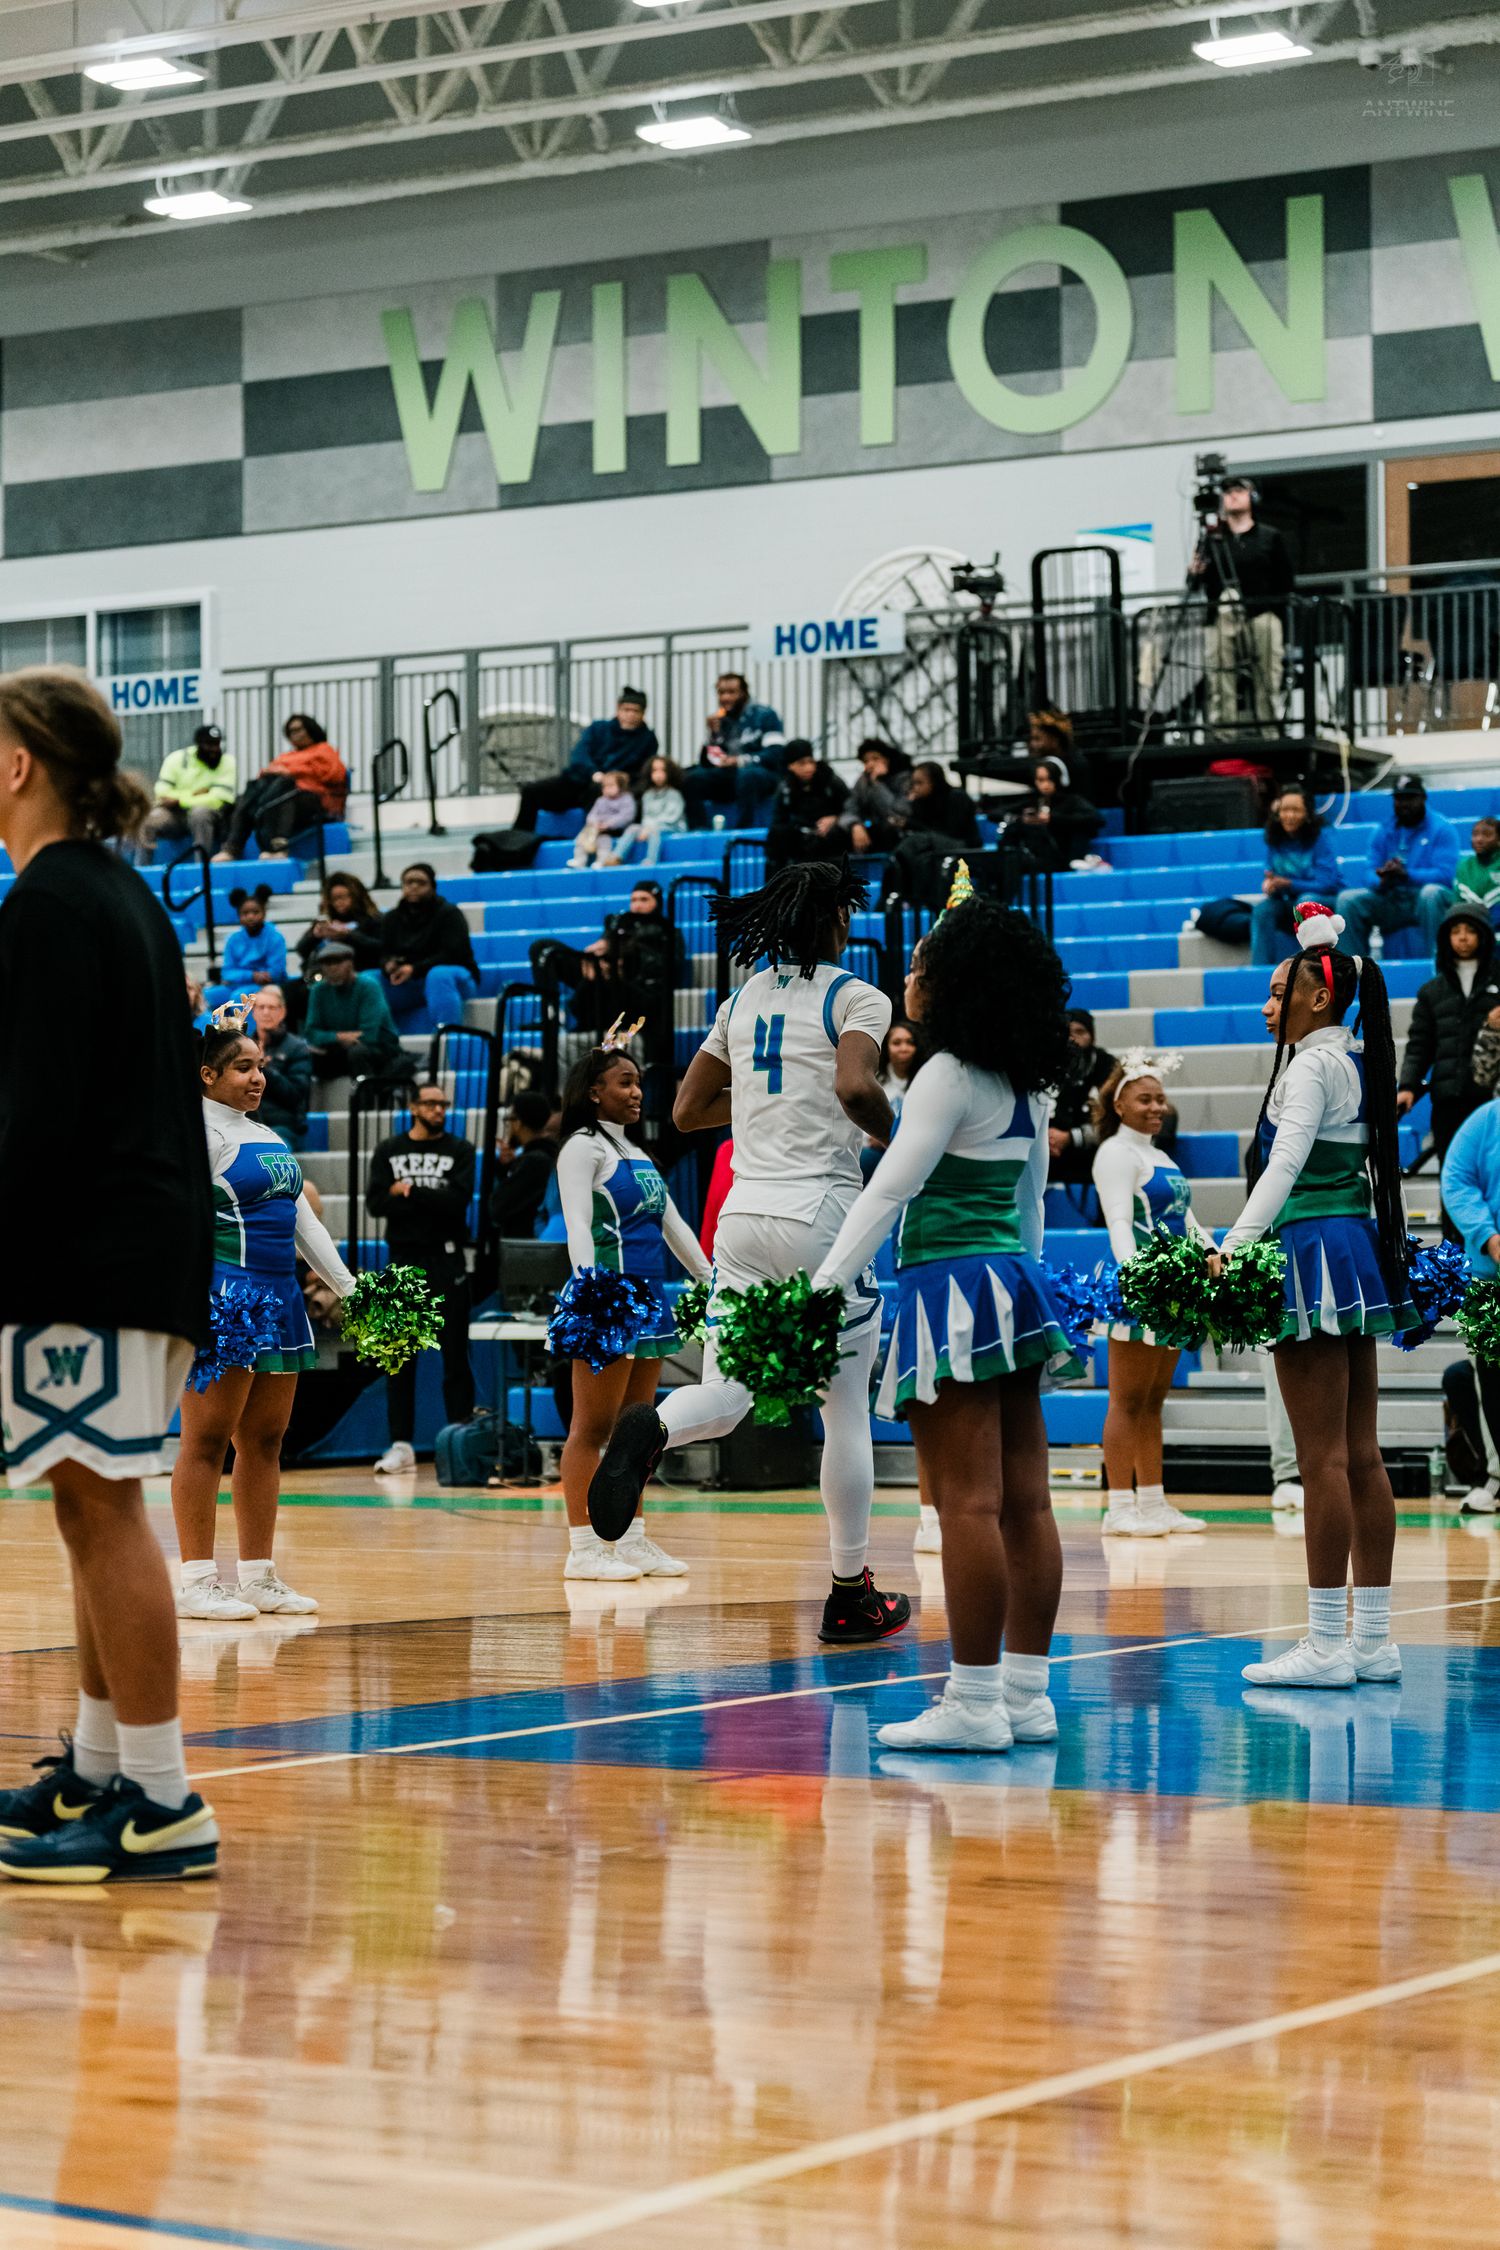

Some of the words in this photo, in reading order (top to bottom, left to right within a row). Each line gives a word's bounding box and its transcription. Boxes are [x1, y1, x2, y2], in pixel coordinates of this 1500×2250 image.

[381, 194, 1325, 492] WINTON
[775, 618, 878, 655] HOME
[112, 675, 199, 709] HOME
[753, 1013, 785, 1094] 4
[389, 1153, 454, 1179] KEEP
[42, 1345, 88, 1386] W
